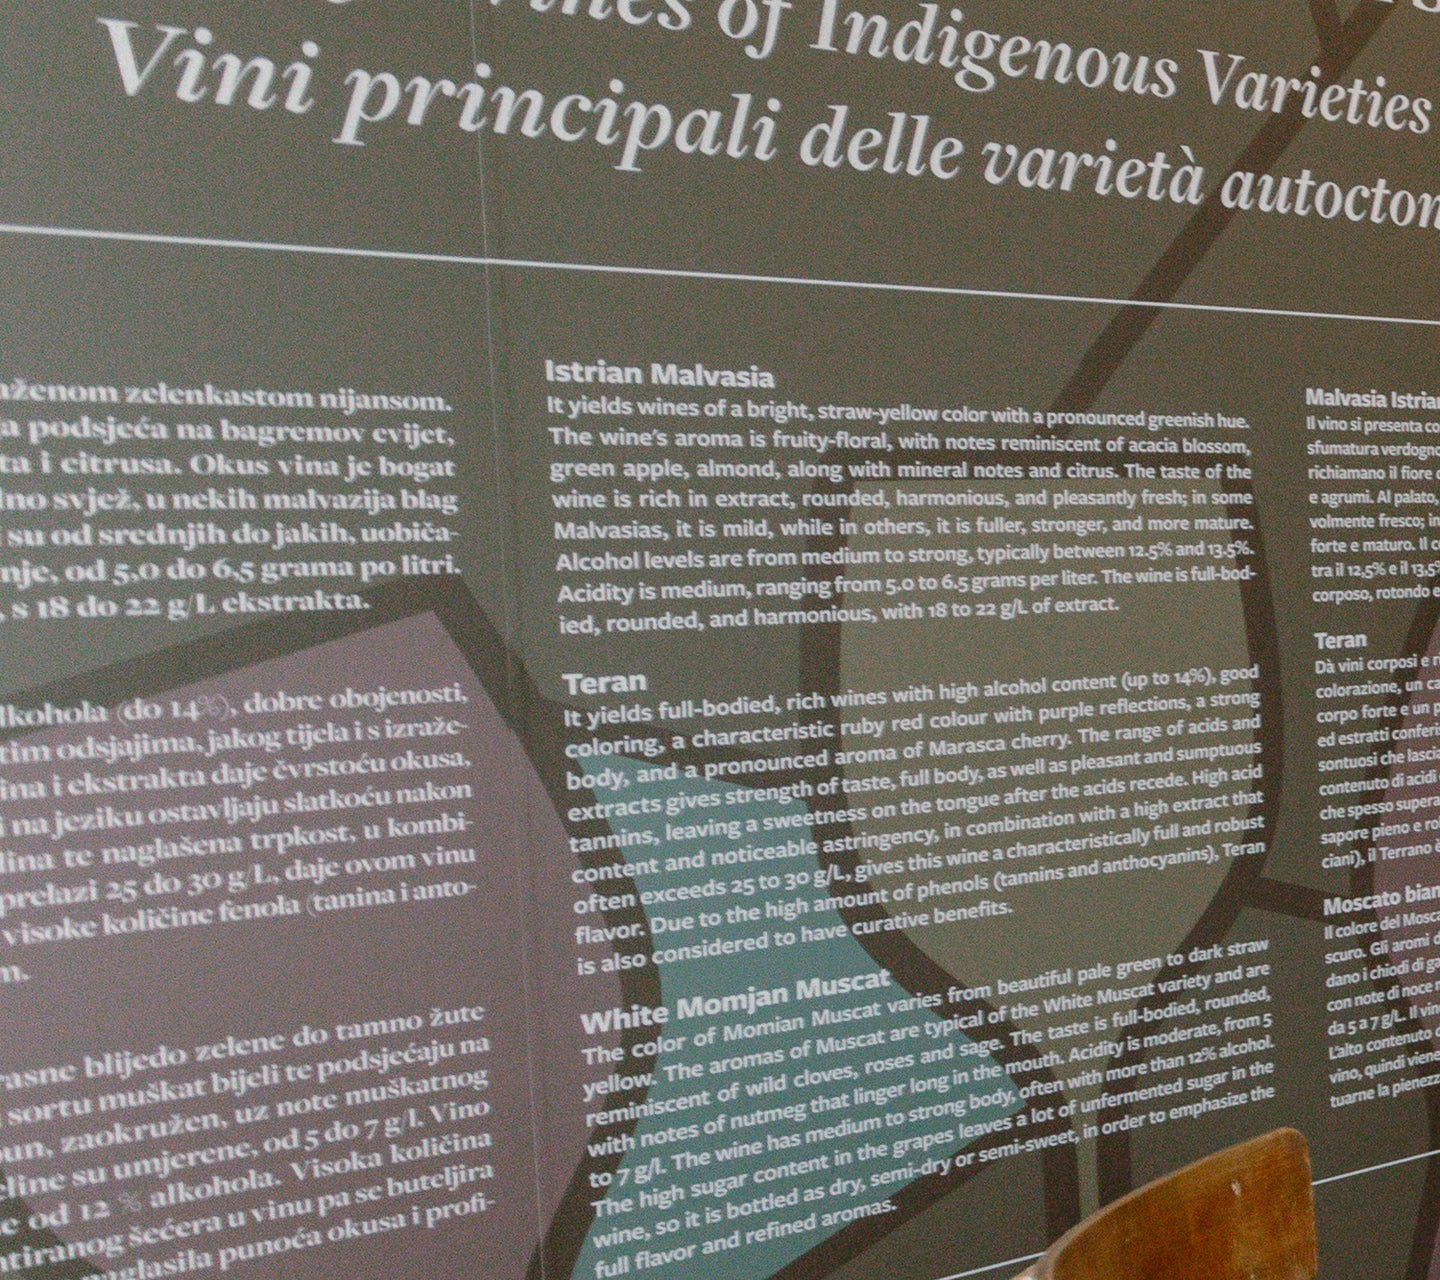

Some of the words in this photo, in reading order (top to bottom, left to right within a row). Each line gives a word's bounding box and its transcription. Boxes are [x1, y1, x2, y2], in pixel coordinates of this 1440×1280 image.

[1200, 49, 1432, 134] Varieties
[101, 18, 319, 114] Vini
[336, 62, 781, 172] principali
[800, 104, 964, 181] delle
[984, 138, 1204, 205] varietà
[546, 359, 642, 384] Istrian
[651, 363, 775, 389] Malvasia
[546, 395, 565, 415] It
[568, 395, 633, 420] yields
[637, 396, 700, 417] wines
[703, 397, 727, 418] of
[730, 403, 744, 419] a
[818, 403, 939, 426] straw-yellow
[942, 405, 988, 423] color
[991, 406, 1030, 424] with
[1032, 410, 1045, 425] a
[1047, 410, 1146, 429] pronounced
[1148, 412, 1215, 432] greenish
[1306, 388, 1387, 408] Malvasia
[547, 425, 593, 447] The
[675, 433, 743, 448] aroma
[749, 428, 767, 449] is
[898, 431, 940, 450] with
[945, 435, 996, 450] notes
[1001, 434, 1101, 453] reminiscent
[1105, 434, 1126, 453] of
[1129, 437, 1178, 454] acacia
[1306, 414, 1316, 430] Il
[1318, 416, 1348, 431] vino
[1349, 416, 1362, 433] si
[1364, 420, 1423, 435] presenta
[7, 528, 46, 547] su
[50, 522, 93, 547] od
[99, 522, 226, 551] srednjih
[231, 521, 271, 545] do
[1314, 633, 1367, 650] Teran
[562, 673, 647, 695] Teran
[671, 734, 686, 751] a
[692, 720, 834, 748] characteristic
[841, 717, 885, 738] ruby
[891, 712, 924, 732] red
[930, 710, 988, 729] colour
[994, 706, 1033, 724] with
[1039, 701, 1094, 725] purple
[1195, 695, 1207, 710] a
[1210, 692, 1260, 709] strong
[1368, 847, 1377, 863] il
[1379, 843, 1432, 860] Terrano
[105, 879, 138, 904] 25
[142, 871, 183, 896] do
[187, 871, 223, 898] 30
[285, 857, 339, 885] daje
[345, 853, 415, 874] ovom
[422, 845, 476, 866] vinu
[3, 916, 97, 945] visoke
[103, 906, 213, 936] količine
[219, 895, 300, 922] fenola
[305, 886, 396, 916] (tanina
[400, 880, 409, 903] i
[1324, 891, 1401, 915] Moscato
[581, 1004, 669, 1034] White
[797, 969, 891, 1000] Muscat
[581, 1044, 625, 1067] The
[632, 1035, 686, 1058] color
[693, 1025, 717, 1048] of
[724, 1015, 804, 1042] Momian
[812, 1002, 881, 1026] Muscat
[887, 992, 942, 1014] varies
[947, 984, 992, 1004] from
[997, 968, 1072, 995] beautiful
[1078, 963, 1111, 986] pale
[1117, 956, 1163, 980] green
[1165, 951, 1185, 968] to
[1188, 943, 1223, 963] dark
[1227, 939, 1269, 957] straw
[8, 1098, 92, 1126] sortu
[211, 1063, 279, 1097] bijeli
[284, 1063, 313, 1083] te
[459, 1036, 491, 1056] na
[1330, 1089, 1374, 1108] tuarne
[1377, 1082, 1390, 1098] la
[234, 1104, 269, 1125] uz
[276, 1093, 337, 1117] note
[327, 1213, 406, 1241] okusa
[411, 1204, 421, 1226] i
[595, 1256, 629, 1280] full
[635, 1244, 696, 1270] flavor
[701, 1229, 741, 1256] and
[746, 1212, 816, 1245] refined
